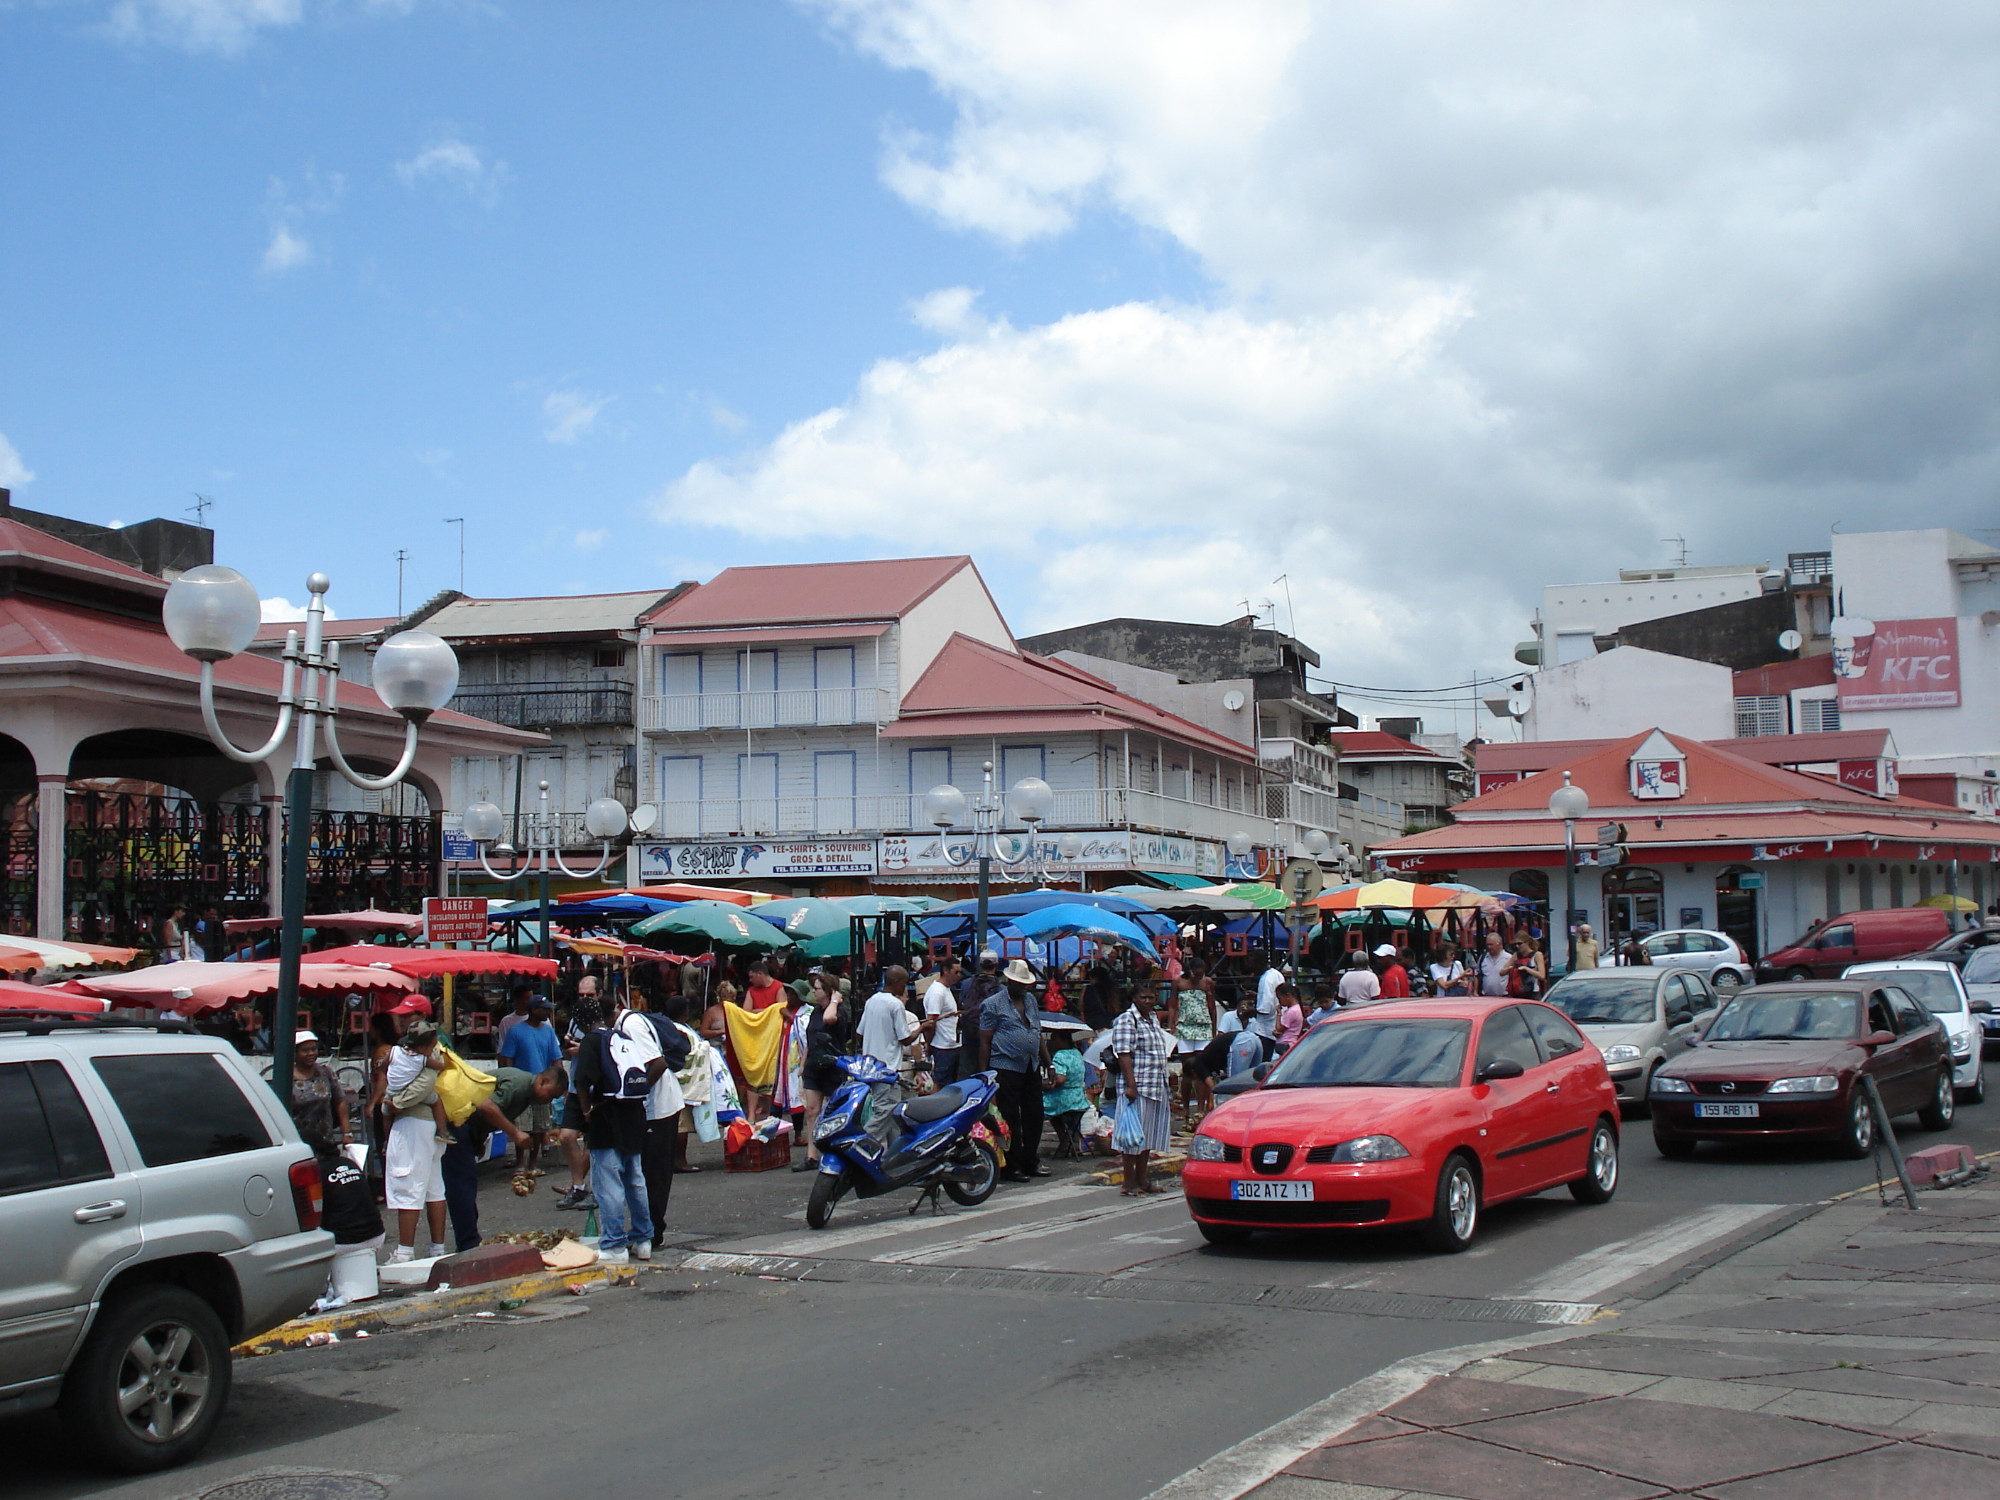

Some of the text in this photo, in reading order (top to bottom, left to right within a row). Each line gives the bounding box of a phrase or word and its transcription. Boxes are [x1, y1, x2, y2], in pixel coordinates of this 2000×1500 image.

[1881, 654, 1952, 682] KFC
[1661, 769, 1678, 780] KFC
[1845, 768, 1875, 780] KFC
[772, 844, 818, 853] TEE-SHIRTS
[824, 843, 872, 852] SOUVENIRS
[884, 846, 908, 858] 1664
[1778, 845, 1804, 858] KFC
[790, 854, 854, 863] GROS & DETAIL
[1401, 855, 1425, 870] KFC
[442, 900, 473, 911] DANGER
[1703, 1105, 1720, 1115] 159
[1723, 1105, 1740, 1115] ARB
[328, 1168, 361, 1183] Corona
[1238, 1183, 1261, 1198] 302
[1264, 1183, 1289, 1198] ATZ
